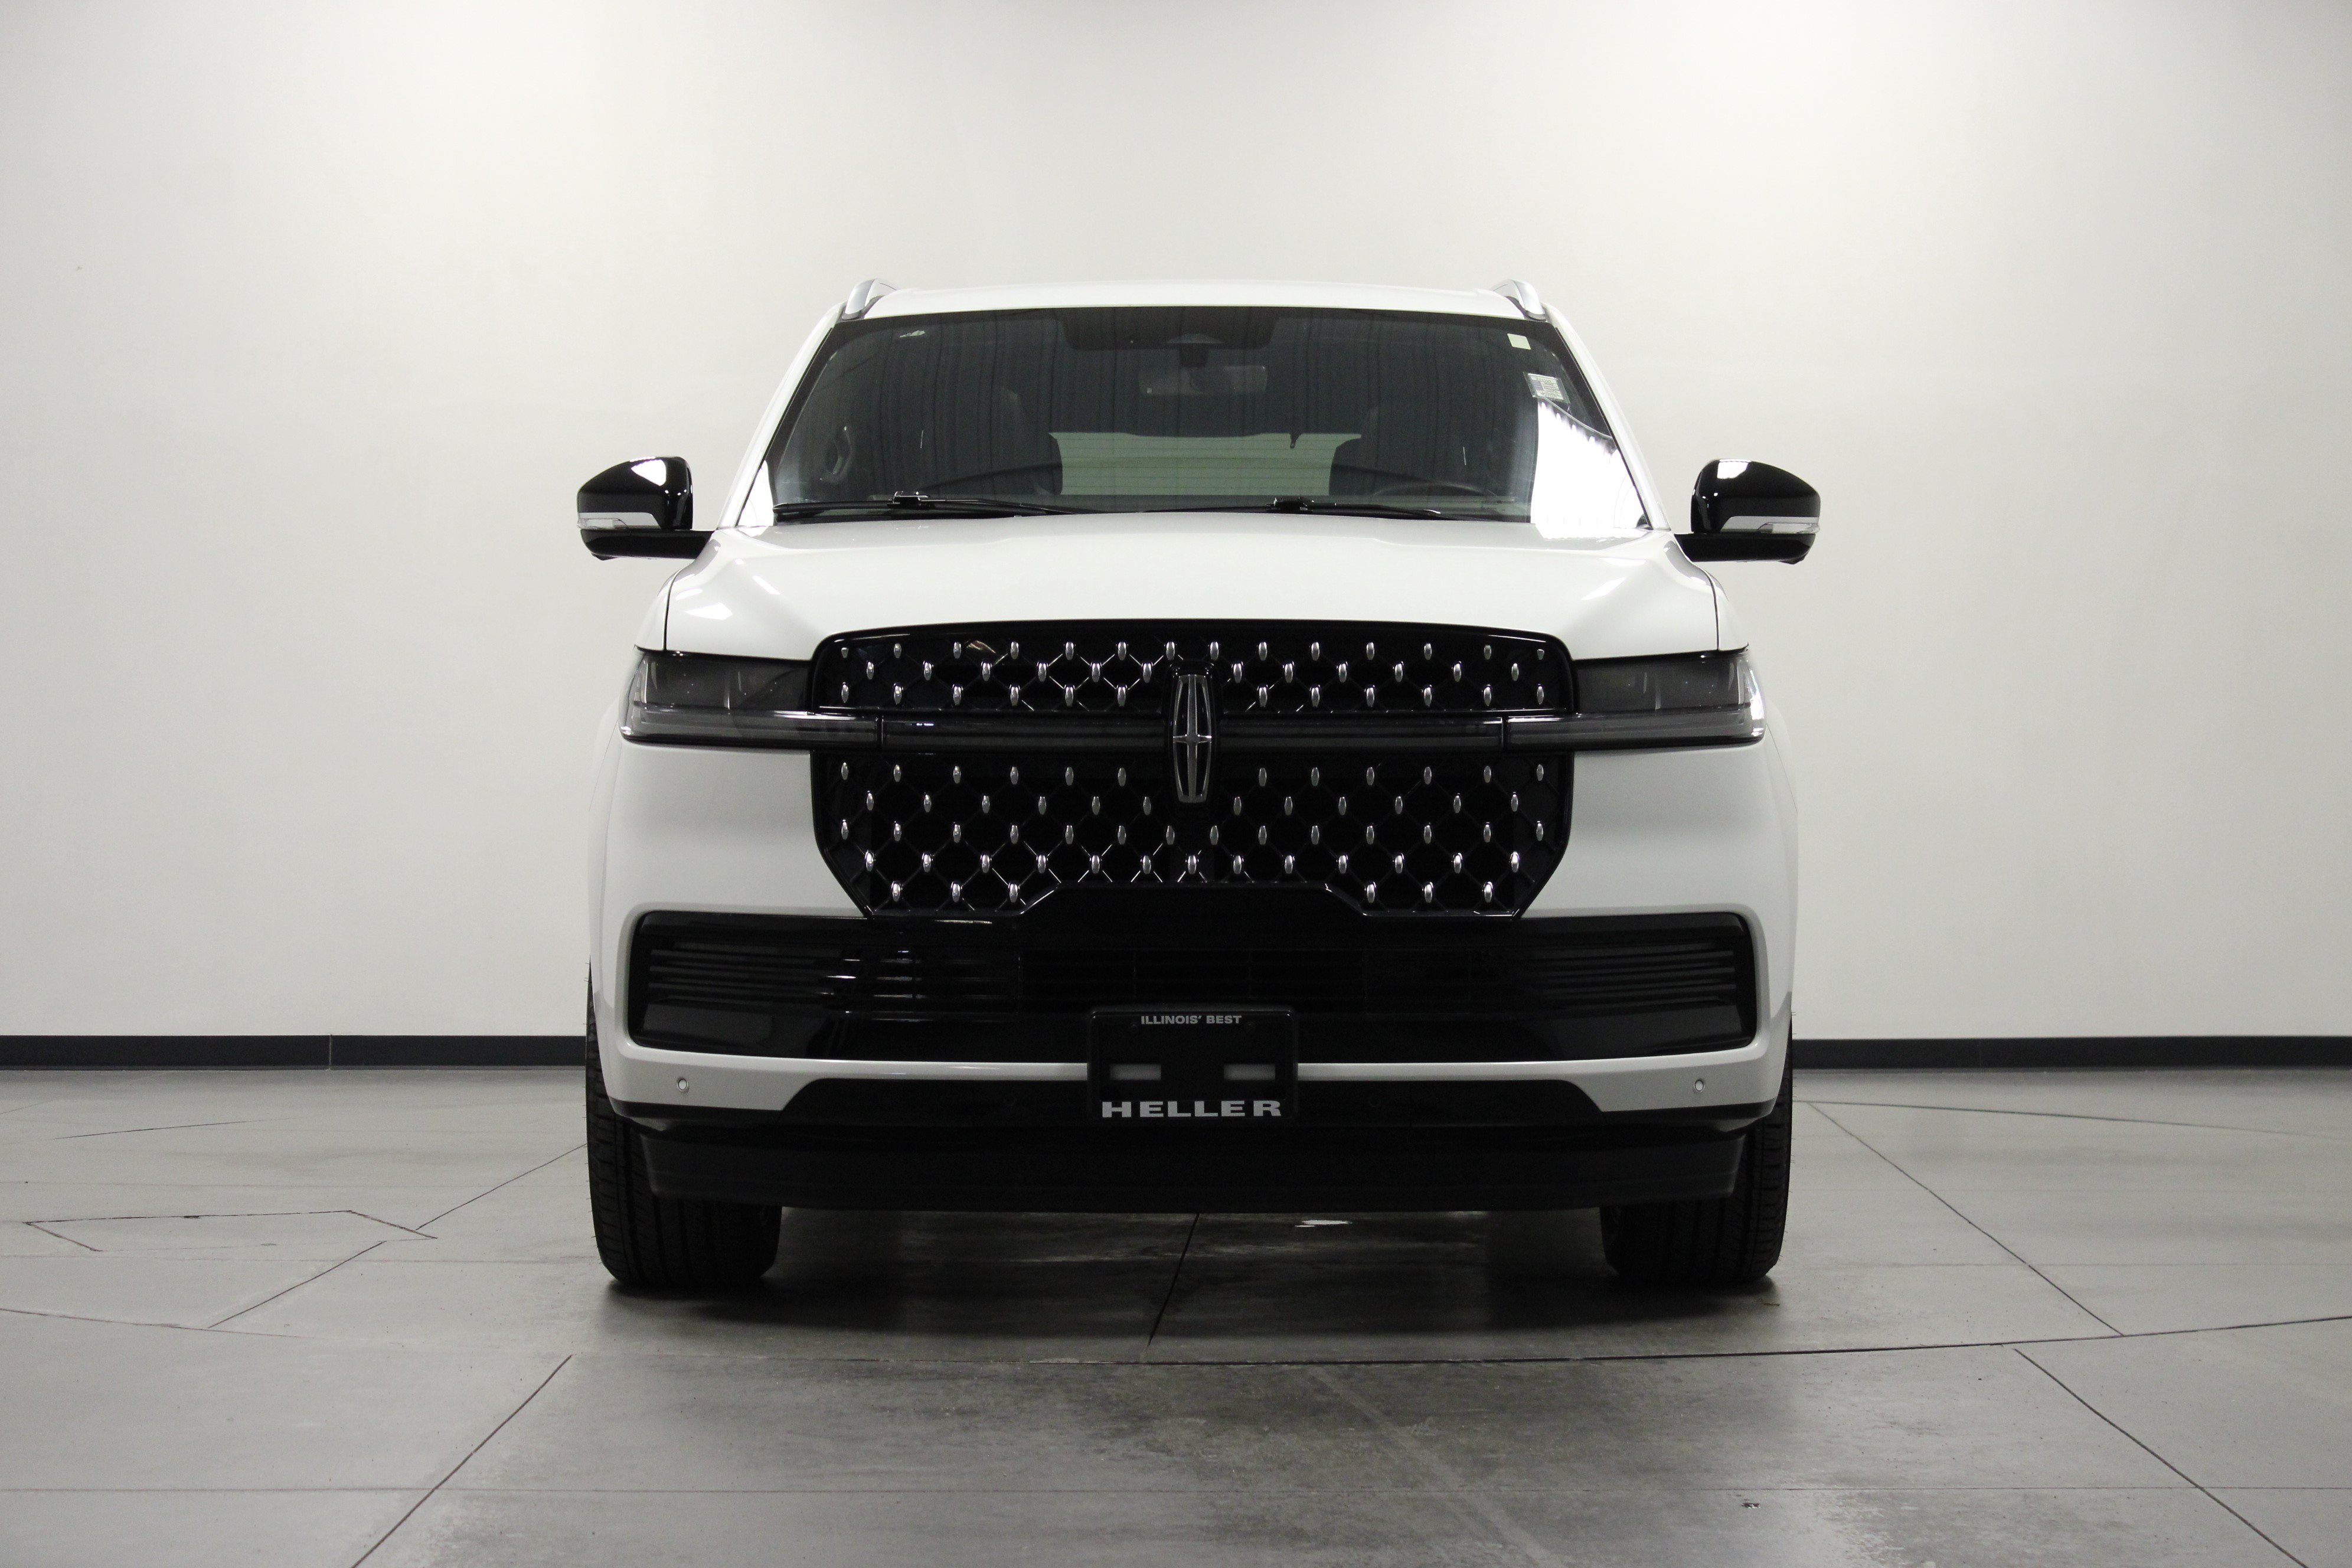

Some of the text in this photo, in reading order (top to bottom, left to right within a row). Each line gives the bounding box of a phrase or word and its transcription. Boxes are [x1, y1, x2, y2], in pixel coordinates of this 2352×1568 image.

[1141, 1015, 1242, 1025] ILLINOIS' BEST
[1102, 1100, 1282, 1118] HELLER
